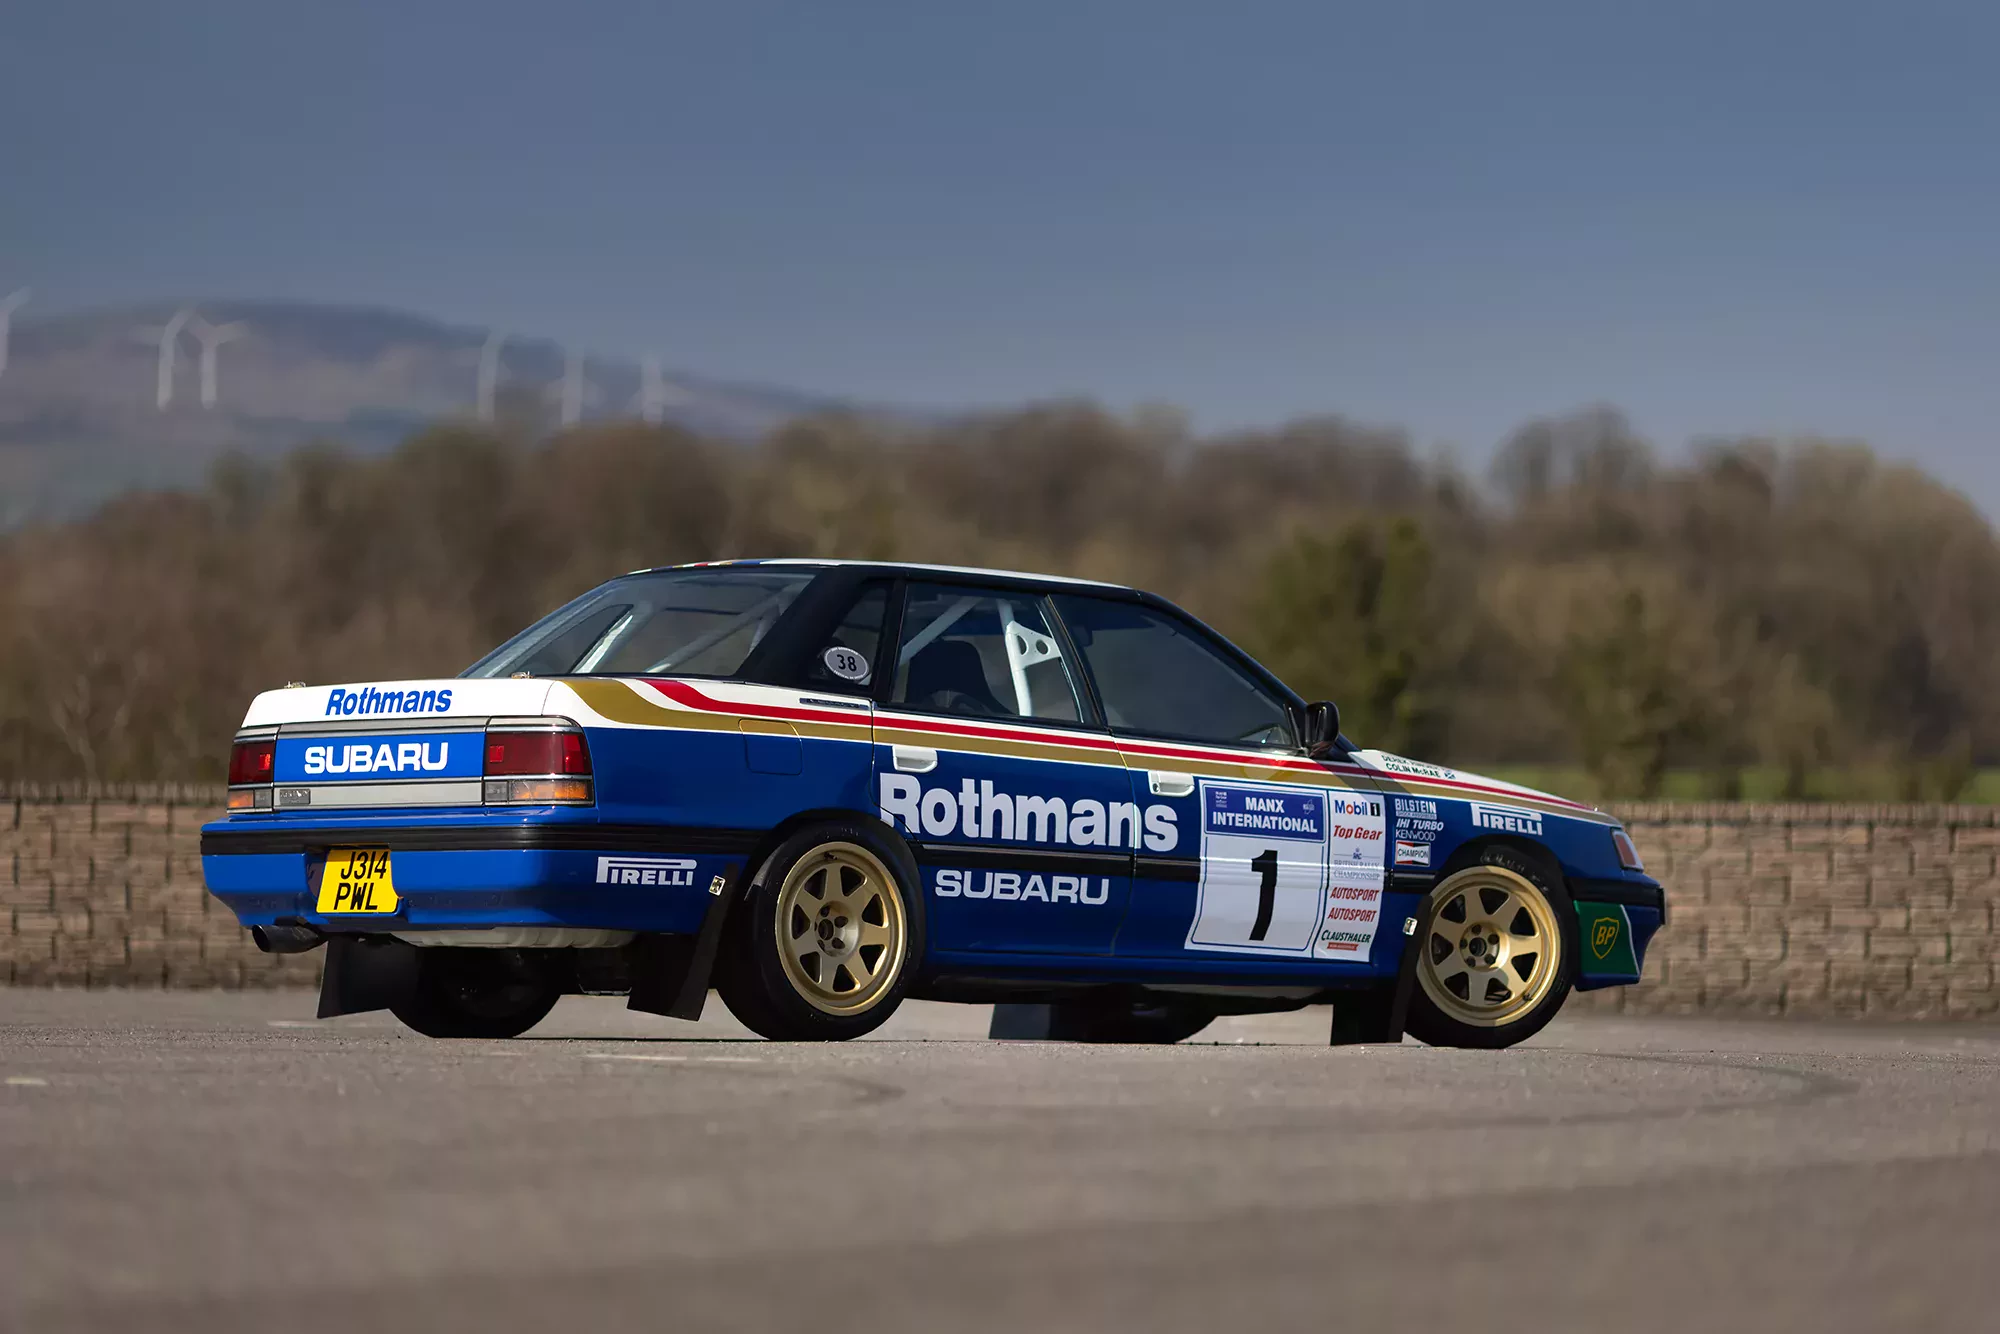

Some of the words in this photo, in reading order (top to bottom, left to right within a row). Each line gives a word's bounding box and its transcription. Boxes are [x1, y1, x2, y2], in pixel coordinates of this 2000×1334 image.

[836, 654, 857, 672] 38
[325, 687, 452, 715] Rothmans
[304, 742, 448, 774] SUBARU
[1386, 763, 1411, 774] COLIN
[880, 772, 1179, 851] Rothmans
[1245, 797, 1285, 813] MANX
[1334, 800, 1368, 816] Mobil
[1395, 798, 1437, 814] BILSTEIN
[1212, 811, 1318, 833] INTERNATIONAL
[1396, 818, 1410, 829] IHI
[1413, 820, 1444, 831] TURBO
[1470, 802, 1542, 835] PIRELLI
[1333, 825, 1354, 839] Top
[1355, 827, 1383, 841] Gear
[1395, 829, 1436, 841] KENWOOD
[1398, 848, 1429, 859] CHAMPION
[340, 851, 388, 879] J314
[596, 856, 697, 885] PIRELLI
[935, 869, 1109, 905] SUBARU
[1249, 849, 1279, 941] 1
[1330, 887, 1379, 901] AUTOSPORT
[333, 882, 379, 911] PWL
[1327, 907, 1377, 922] AUTOSPORT
[1321, 929, 1371, 943] CLAUSTHALER
[1596, 924, 1616, 946] BP
